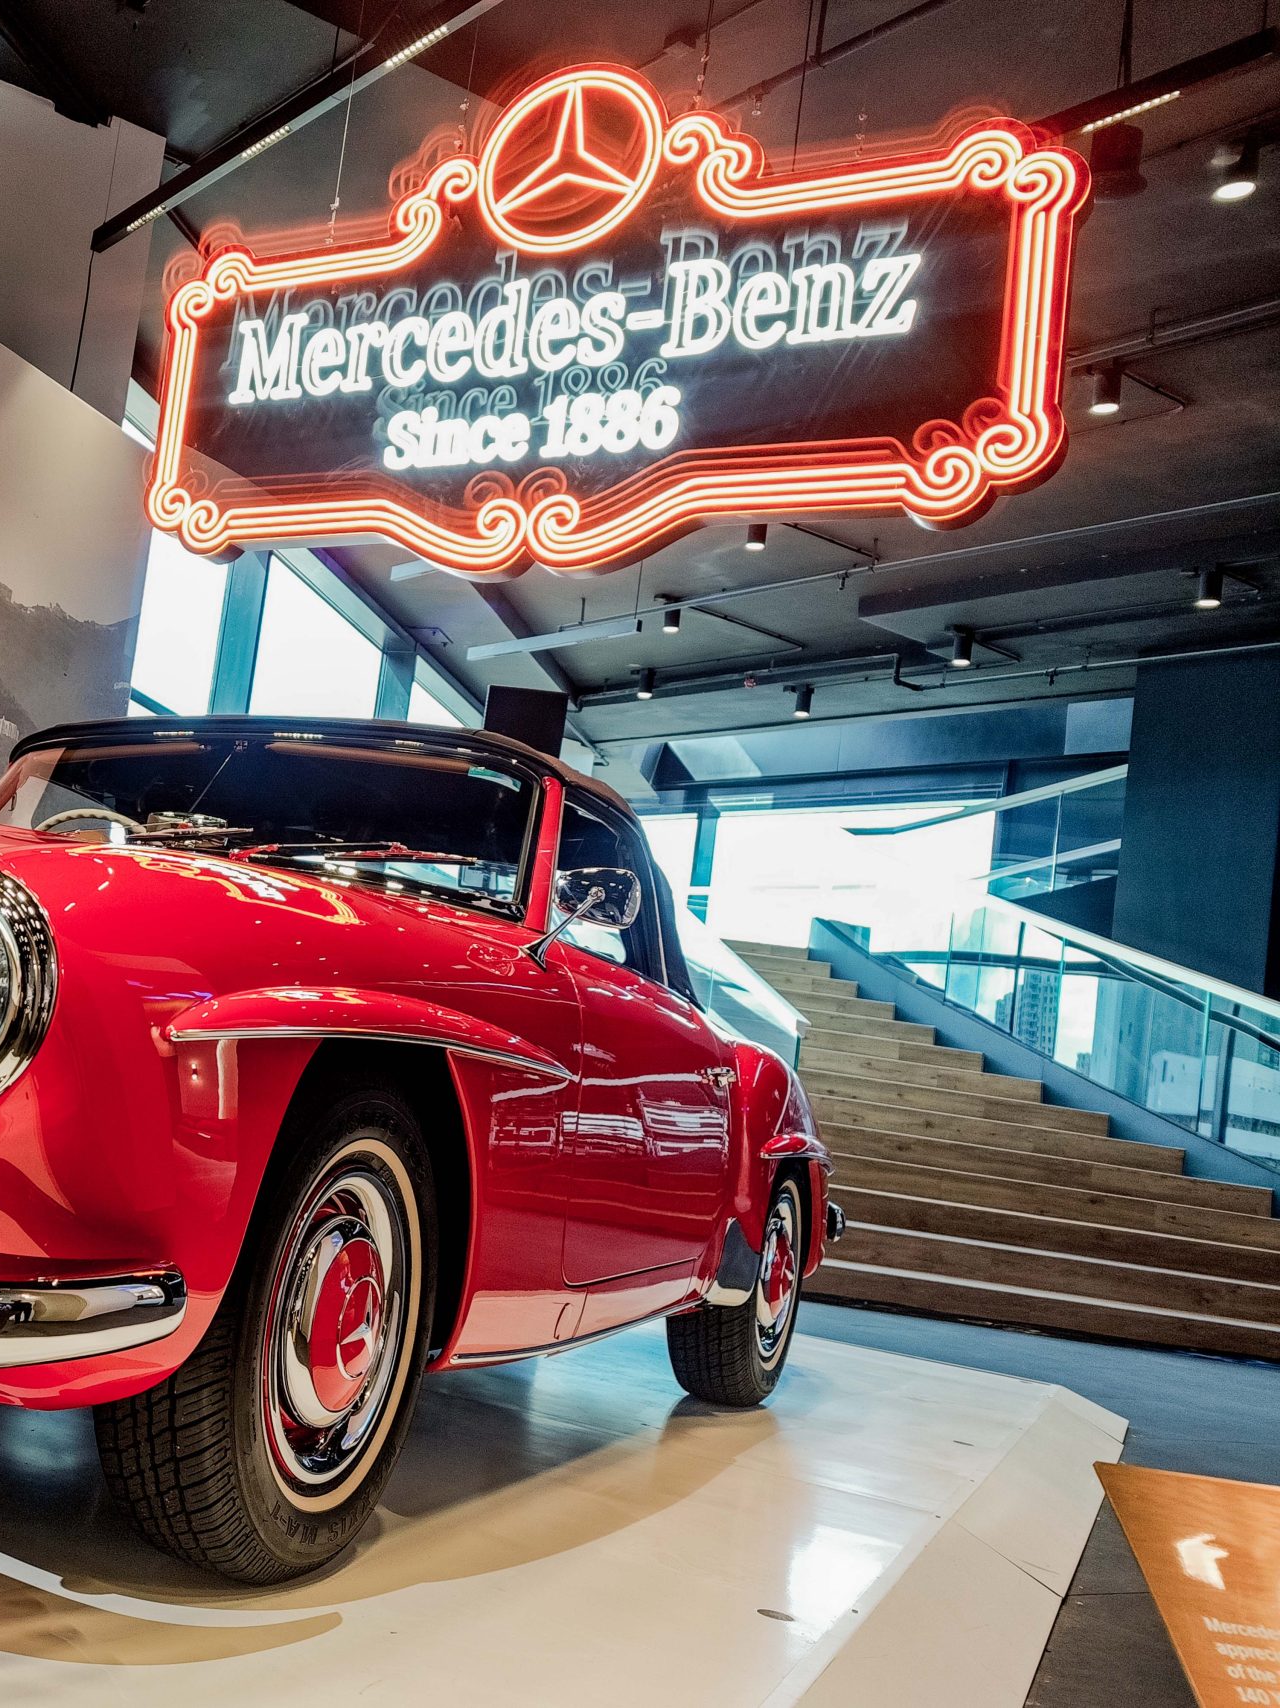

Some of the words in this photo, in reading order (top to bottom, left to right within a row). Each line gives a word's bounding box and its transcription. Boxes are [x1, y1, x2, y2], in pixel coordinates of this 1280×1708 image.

[228, 253, 922, 405] Mercedes-Benz
[383, 405, 531, 471] Since
[539, 385, 682, 459] 1886
[1227, 1664, 1247, 1680] of
[1247, 1666, 1277, 1684] the
